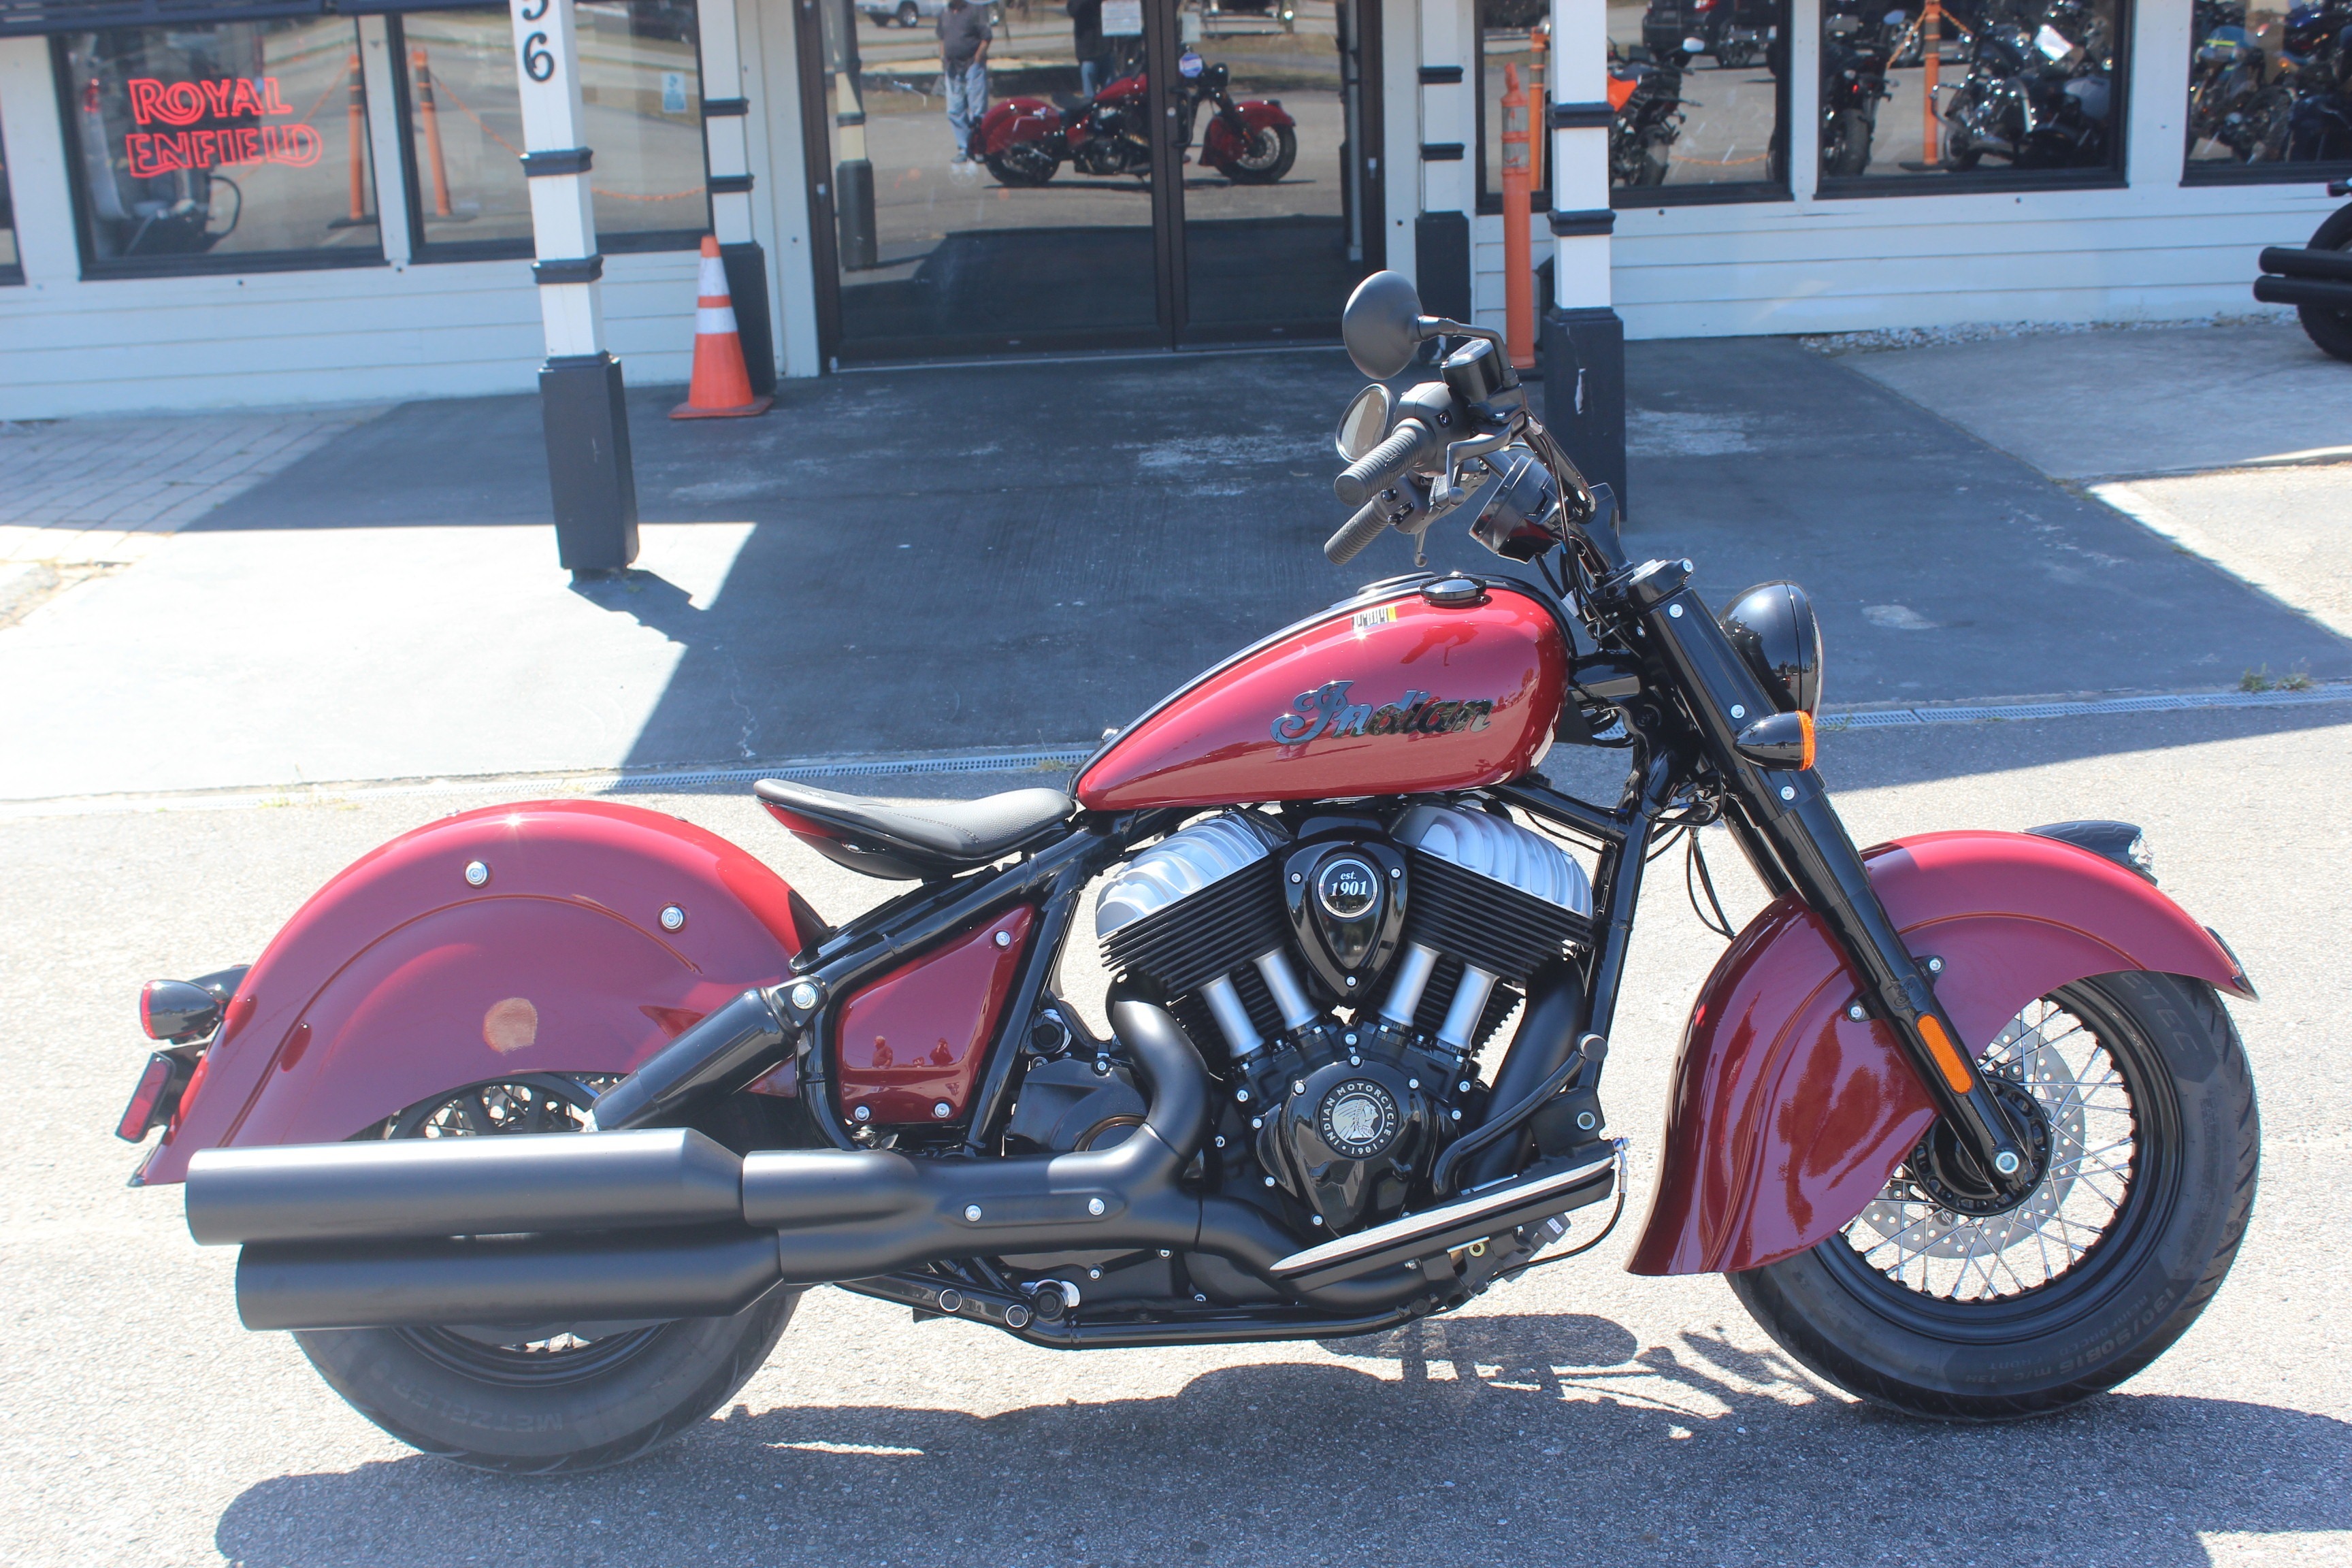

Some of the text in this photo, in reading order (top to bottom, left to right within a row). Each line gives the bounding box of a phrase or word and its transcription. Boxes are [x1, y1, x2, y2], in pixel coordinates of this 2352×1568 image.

[129, 77, 293, 125] ROYAL
[126, 123, 323, 178] ENFIELD
[1271, 681, 1494, 746] Indian
[1330, 881, 1367, 897] 1901
[1340, 870, 1356, 880] est.
[1323, 1083, 1394, 1145] INDIAN MOTORCYCLE
[1352, 1143, 1378, 1154] 1901
[392, 1383, 562, 1433] METZELER
